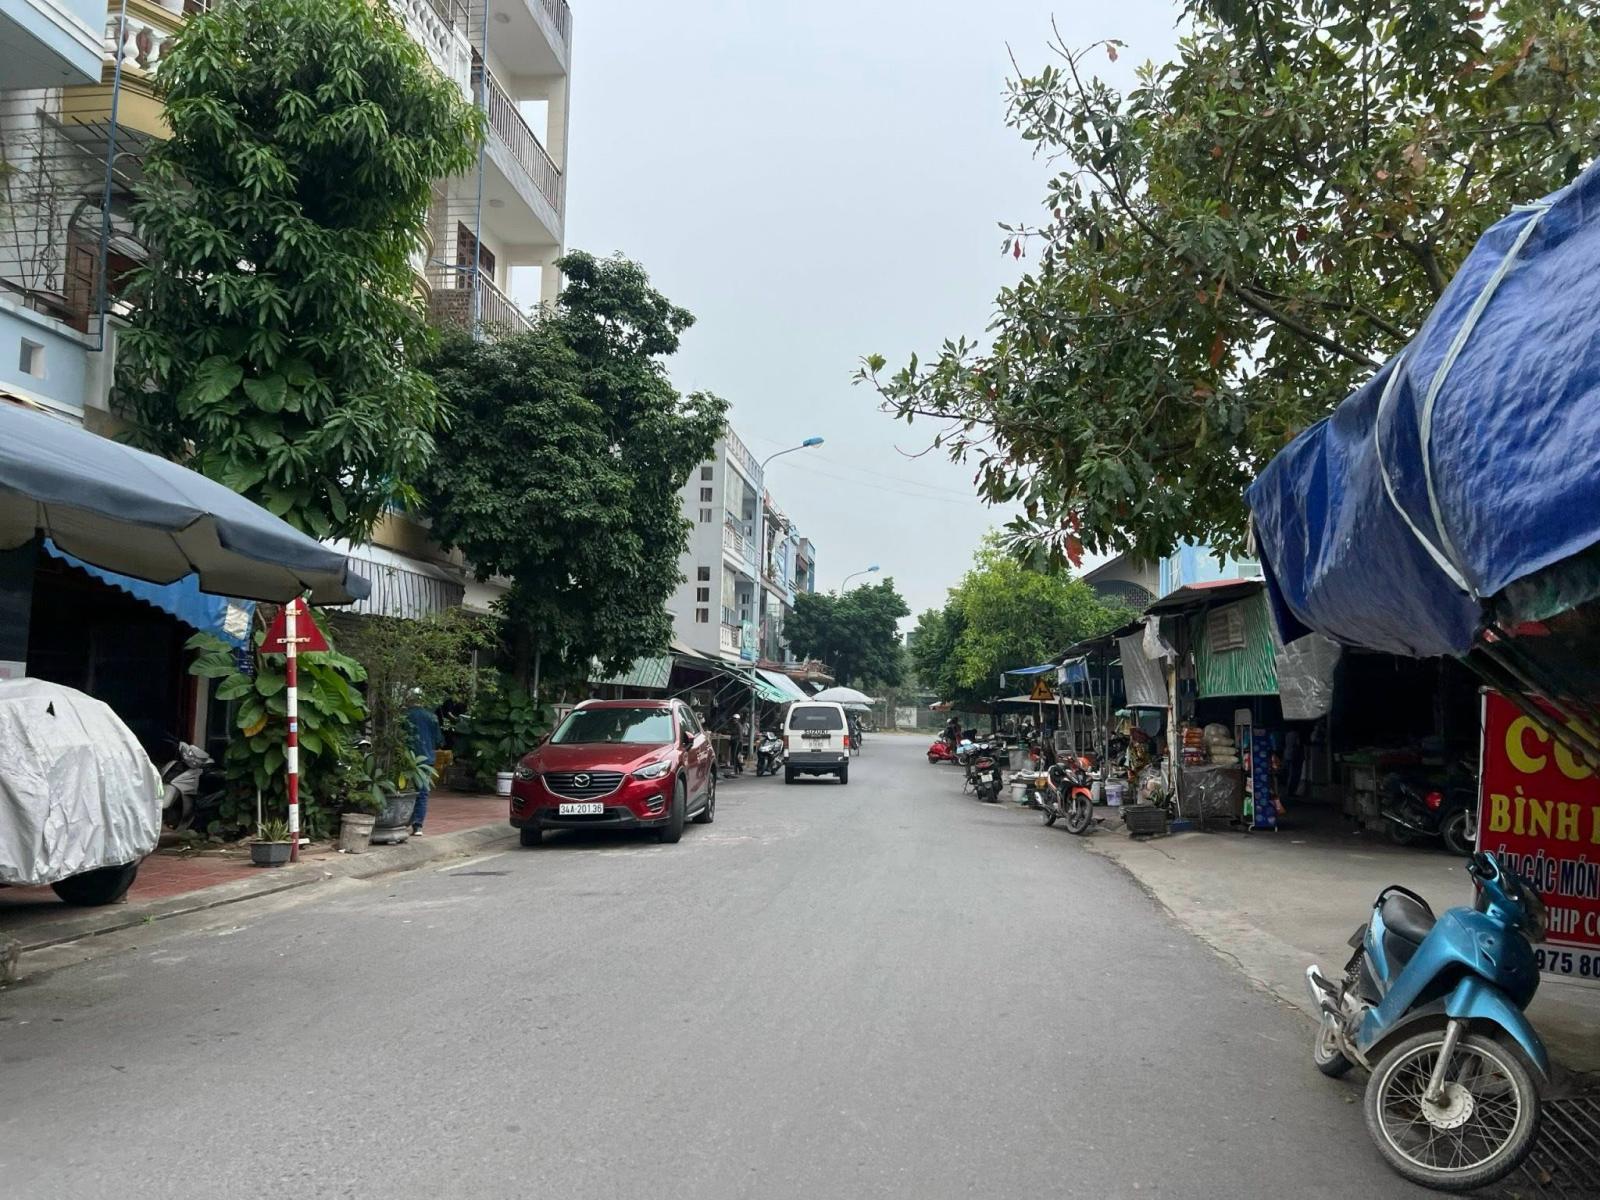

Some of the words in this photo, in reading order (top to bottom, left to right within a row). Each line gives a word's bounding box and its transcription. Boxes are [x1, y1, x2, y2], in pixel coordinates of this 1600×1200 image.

[1488, 785, 1581, 841] BÌNH
[1523, 848, 1558, 894] CÁC
[1559, 854, 1600, 900] MÓN
